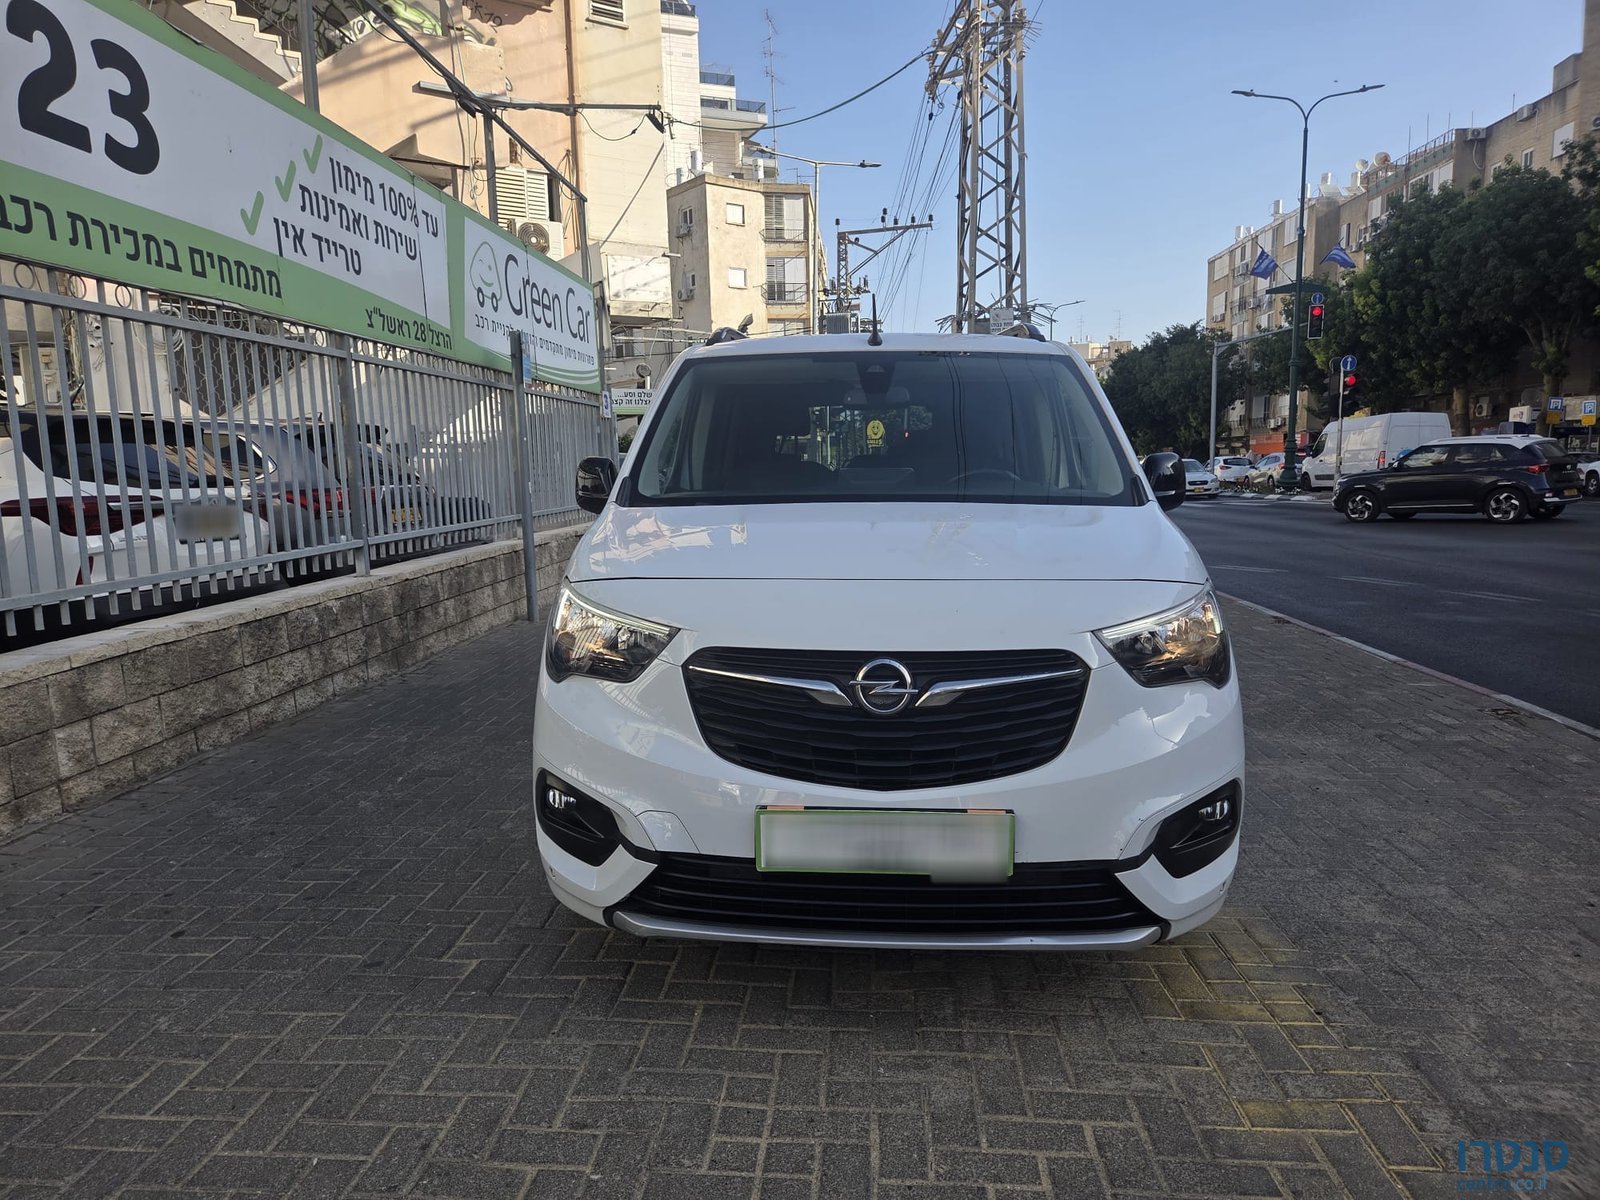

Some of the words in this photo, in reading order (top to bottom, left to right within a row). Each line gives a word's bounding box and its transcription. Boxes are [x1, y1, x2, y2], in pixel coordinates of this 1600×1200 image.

[6, 0, 160, 175] 23
[329, 156, 375, 205] מימון
[298, 183, 369, 241] ואמינות
[379, 182, 420, 228] 100%
[422, 209, 439, 238] עד
[66, 210, 183, 273] במכירת
[273, 217, 307, 257] אין
[311, 232, 362, 276] טרייד
[373, 219, 417, 261] שירות
[188, 246, 282, 298] מתמחים
[505, 253, 564, 334] Green
[566, 287, 590, 343] Car
[413, 320, 427, 343] 28
[429, 323, 452, 350] הרצל
[474, 313, 490, 331] רכב
